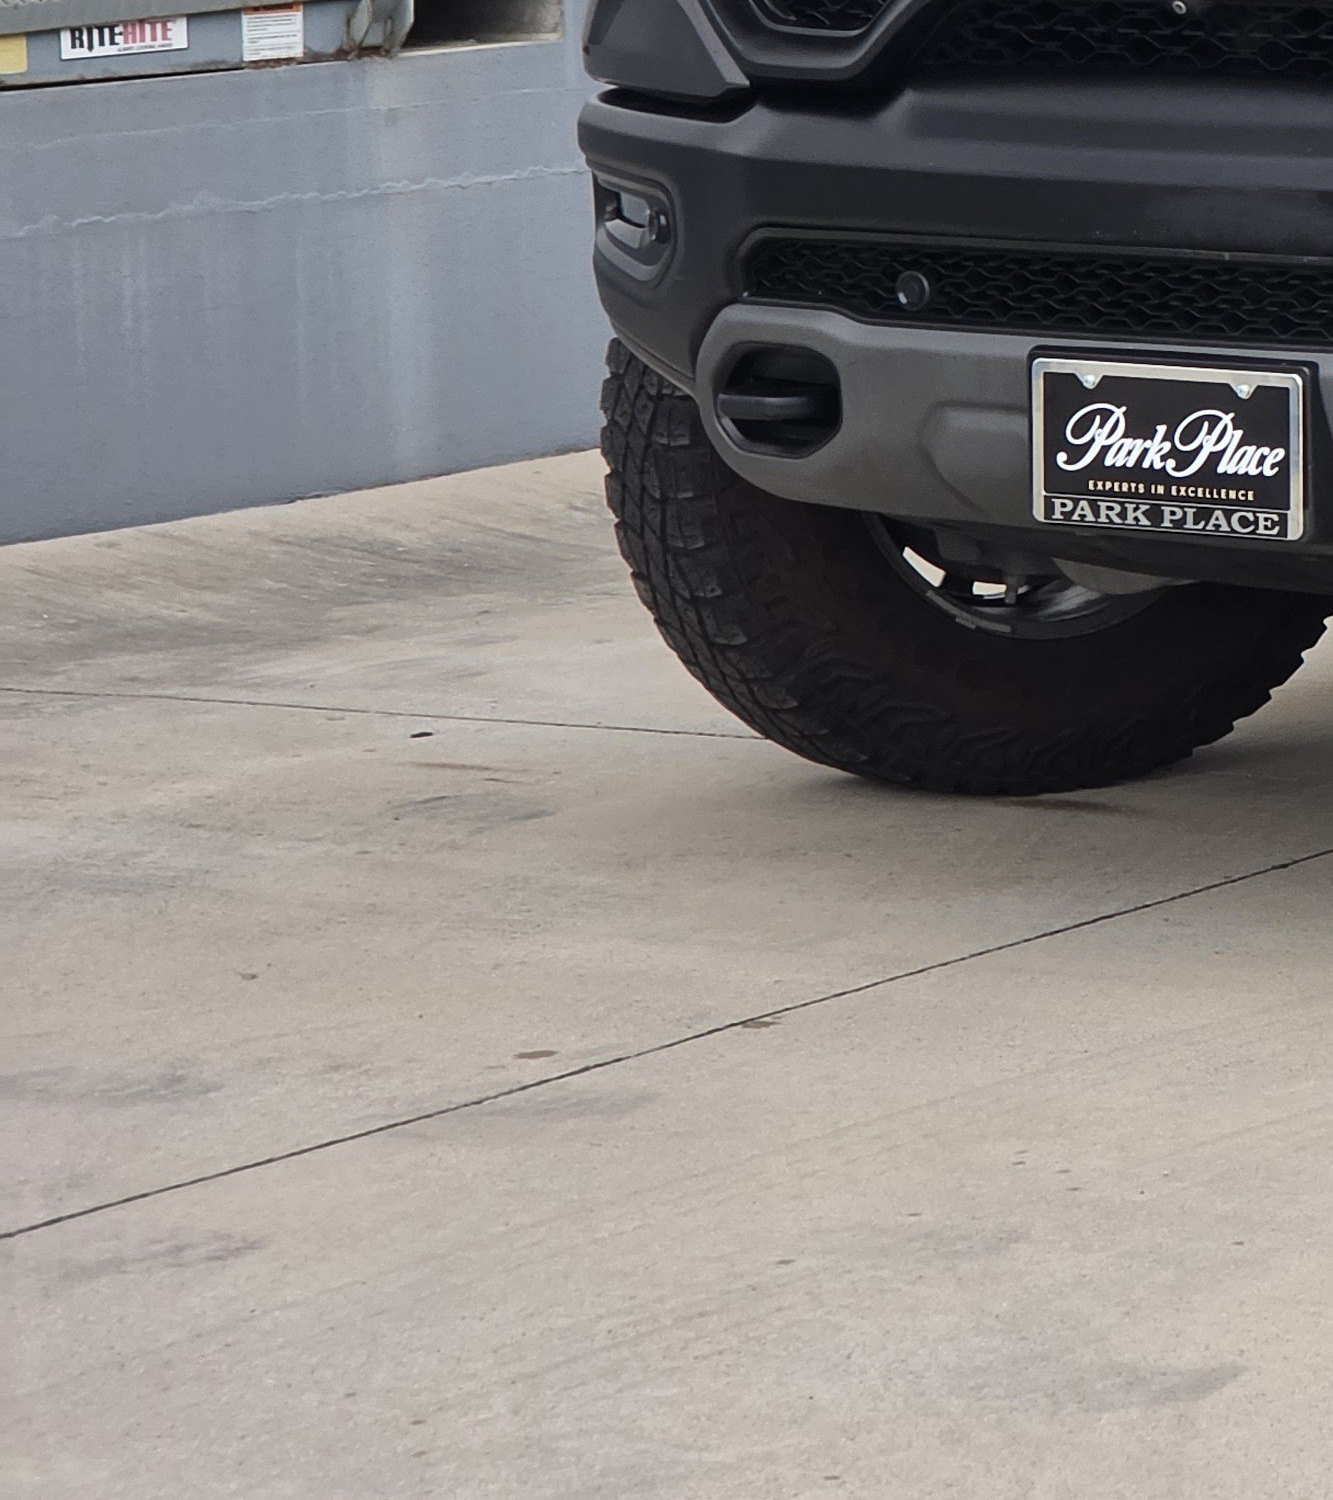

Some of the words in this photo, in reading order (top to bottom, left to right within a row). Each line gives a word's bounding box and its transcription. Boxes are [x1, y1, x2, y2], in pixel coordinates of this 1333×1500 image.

[1056, 403, 1172, 471] Park
[1165, 409, 1286, 477] Place
[1088, 479, 1145, 494] EXPERTS
[1150, 484, 1165, 495] IN
[1170, 485, 1255, 501] EXCELLENCE
[1050, 498, 1152, 527] PARK
[1160, 507, 1281, 536] PLACE
